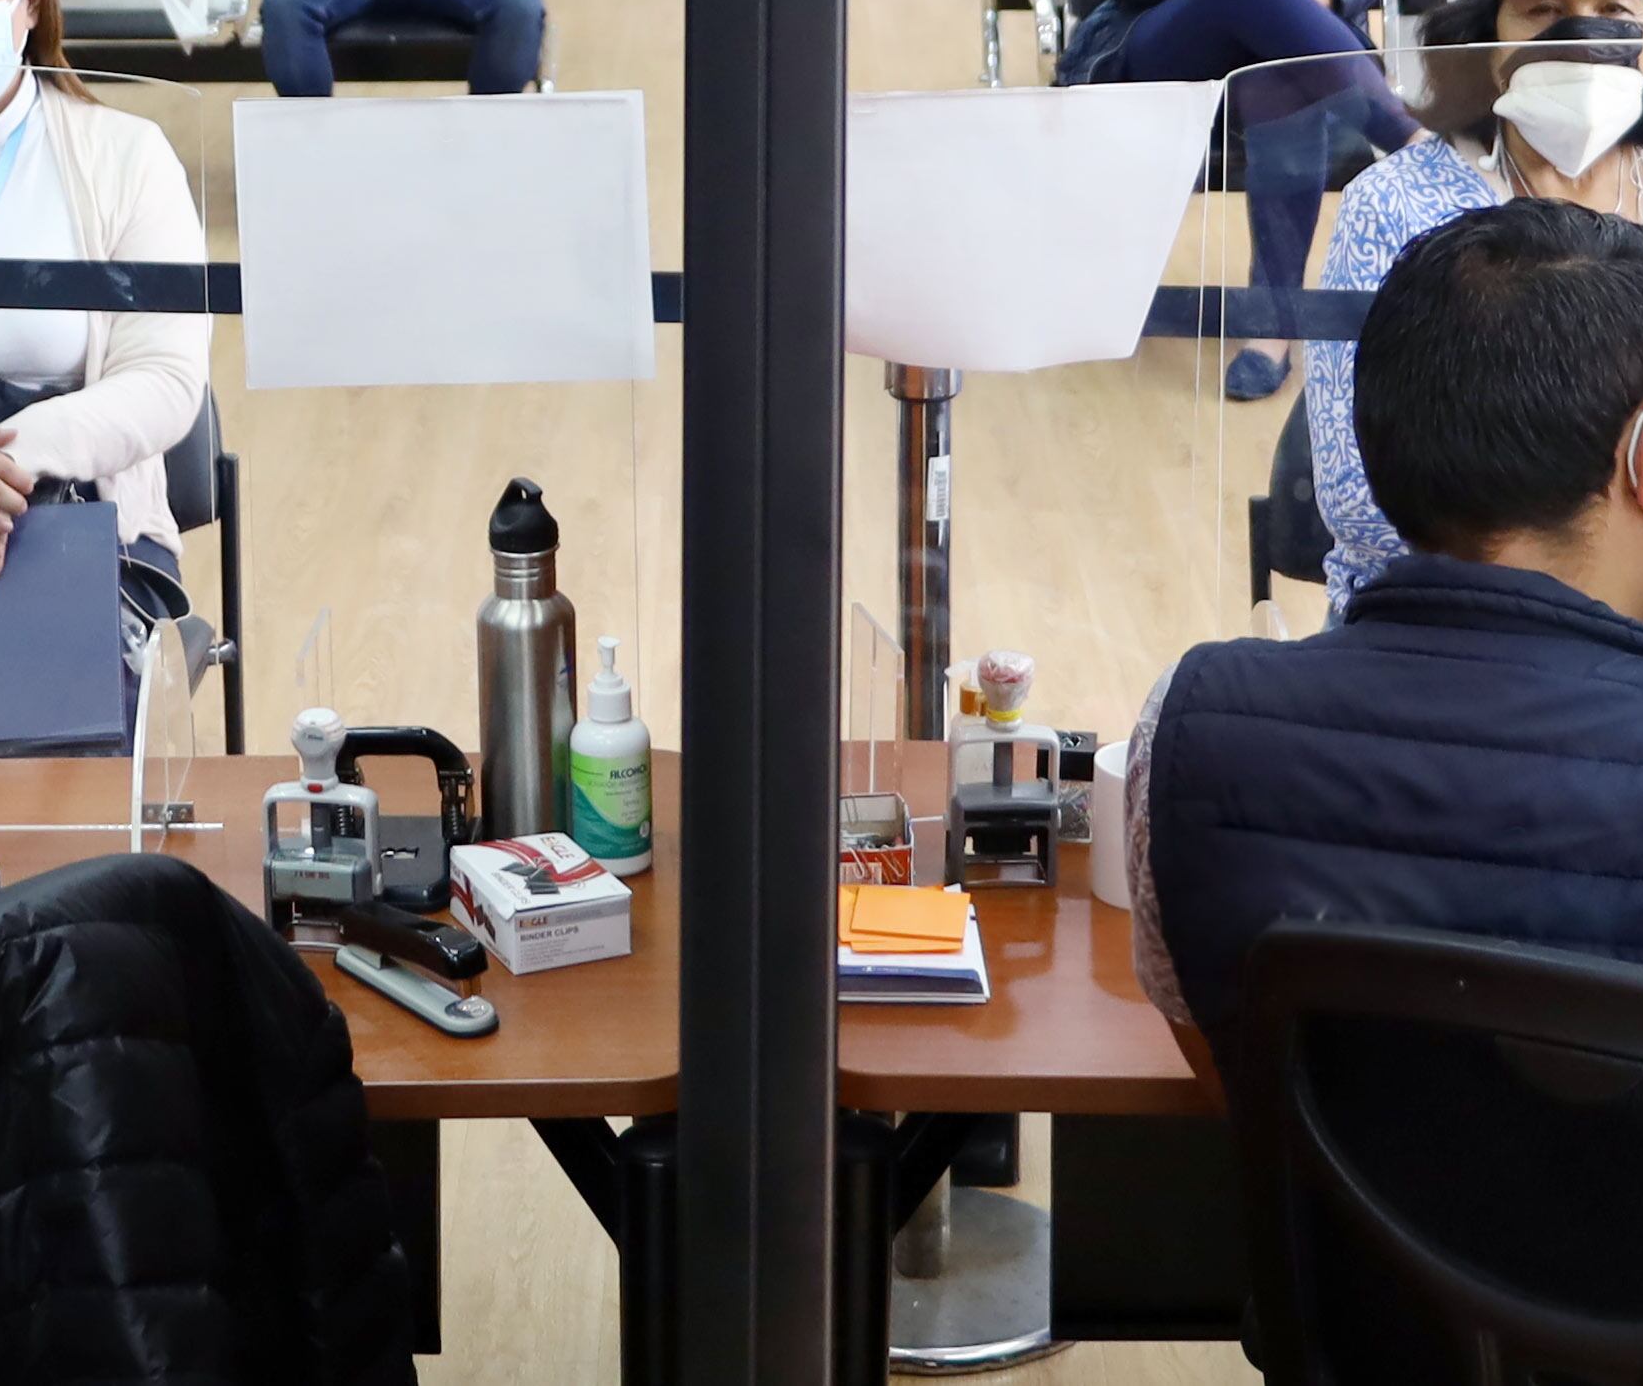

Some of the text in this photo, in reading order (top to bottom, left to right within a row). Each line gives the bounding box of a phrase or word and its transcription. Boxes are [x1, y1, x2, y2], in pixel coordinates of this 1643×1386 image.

[609, 763, 648, 779] ALCOHO
[519, 925, 580, 943] BINDER CLIPS
